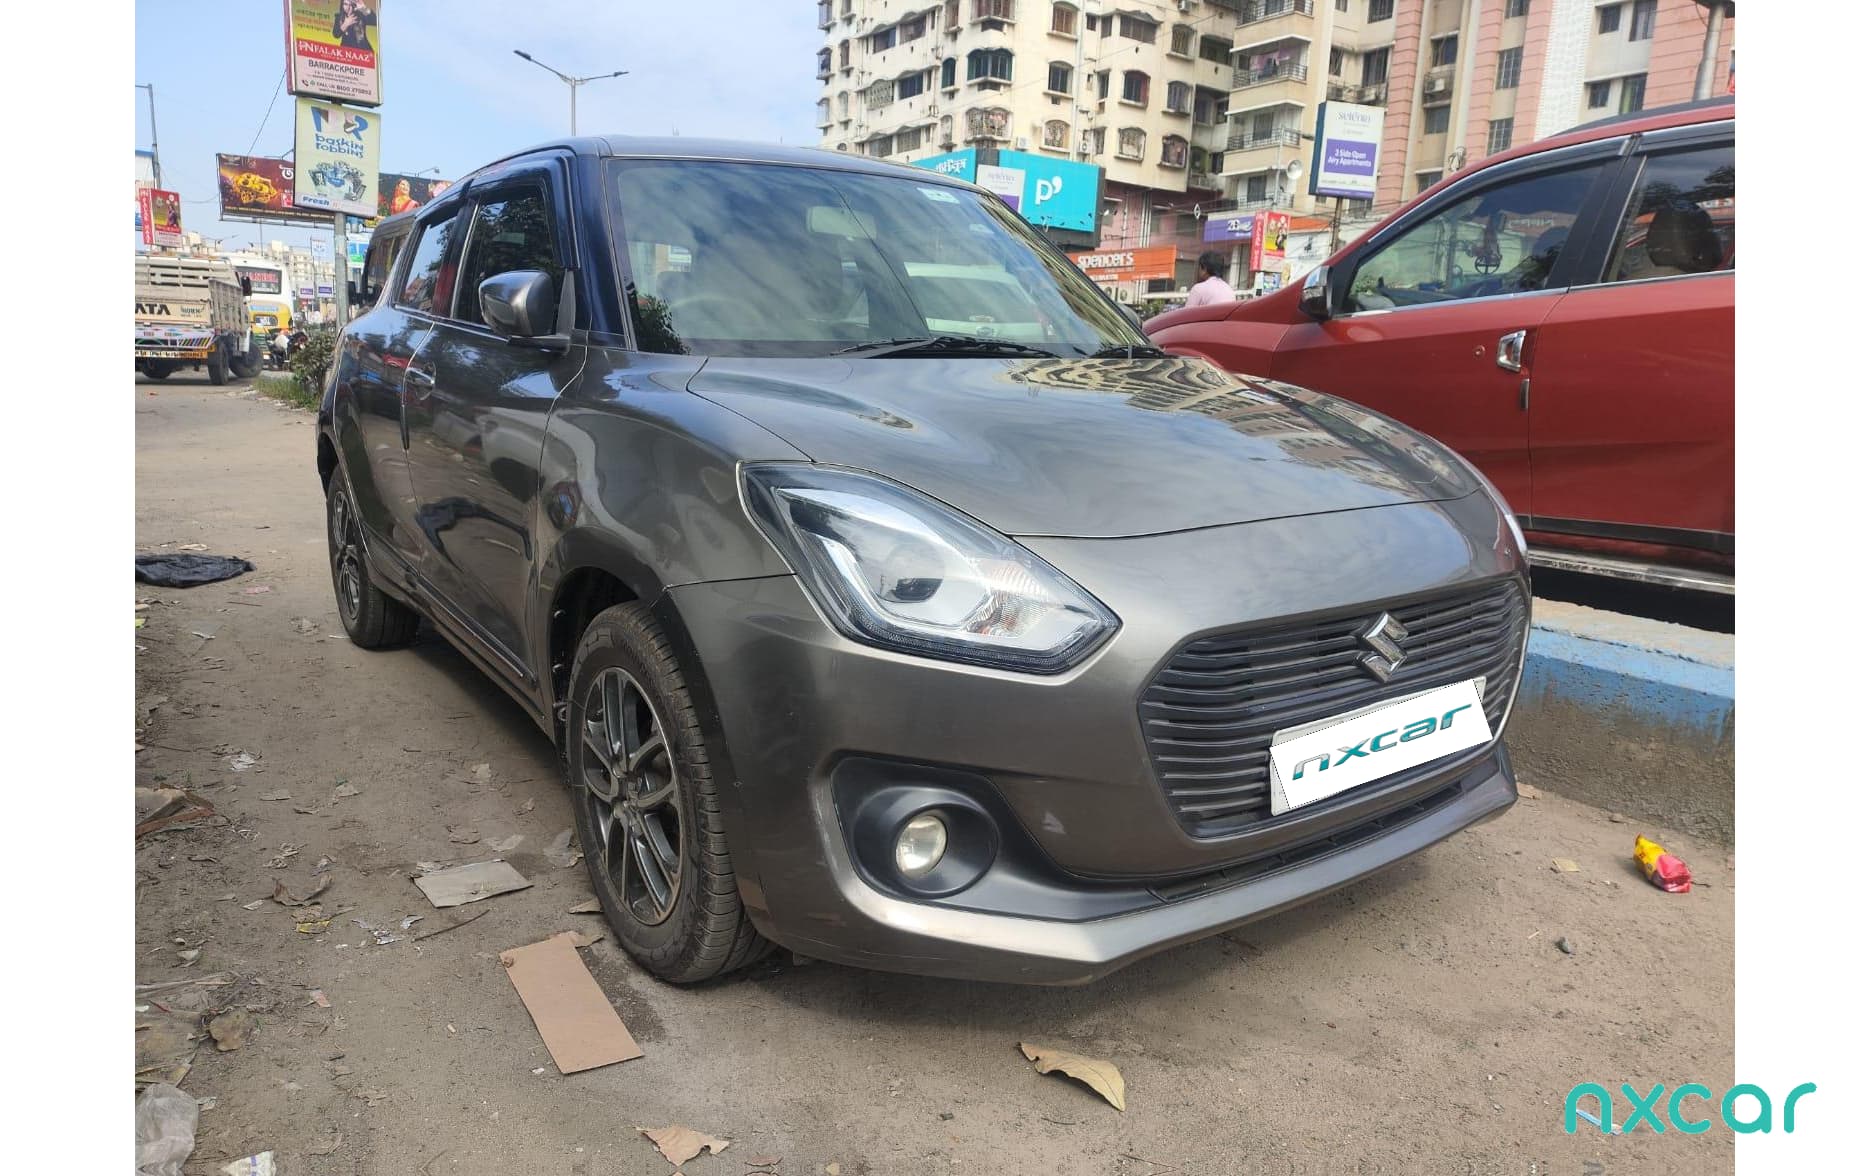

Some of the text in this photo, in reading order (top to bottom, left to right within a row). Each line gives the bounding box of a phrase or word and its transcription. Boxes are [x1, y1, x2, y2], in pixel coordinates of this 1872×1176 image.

[345, 50, 371, 63] NAAZ
[308, 60, 365, 76] BARRACKPORE
[314, 133, 364, 151] baskin
[315, 142, 364, 159] robbins
[1352, 150, 1367, 160] Open
[1340, 157, 1372, 168] Apartments
[135, 303, 171, 315] ATA
